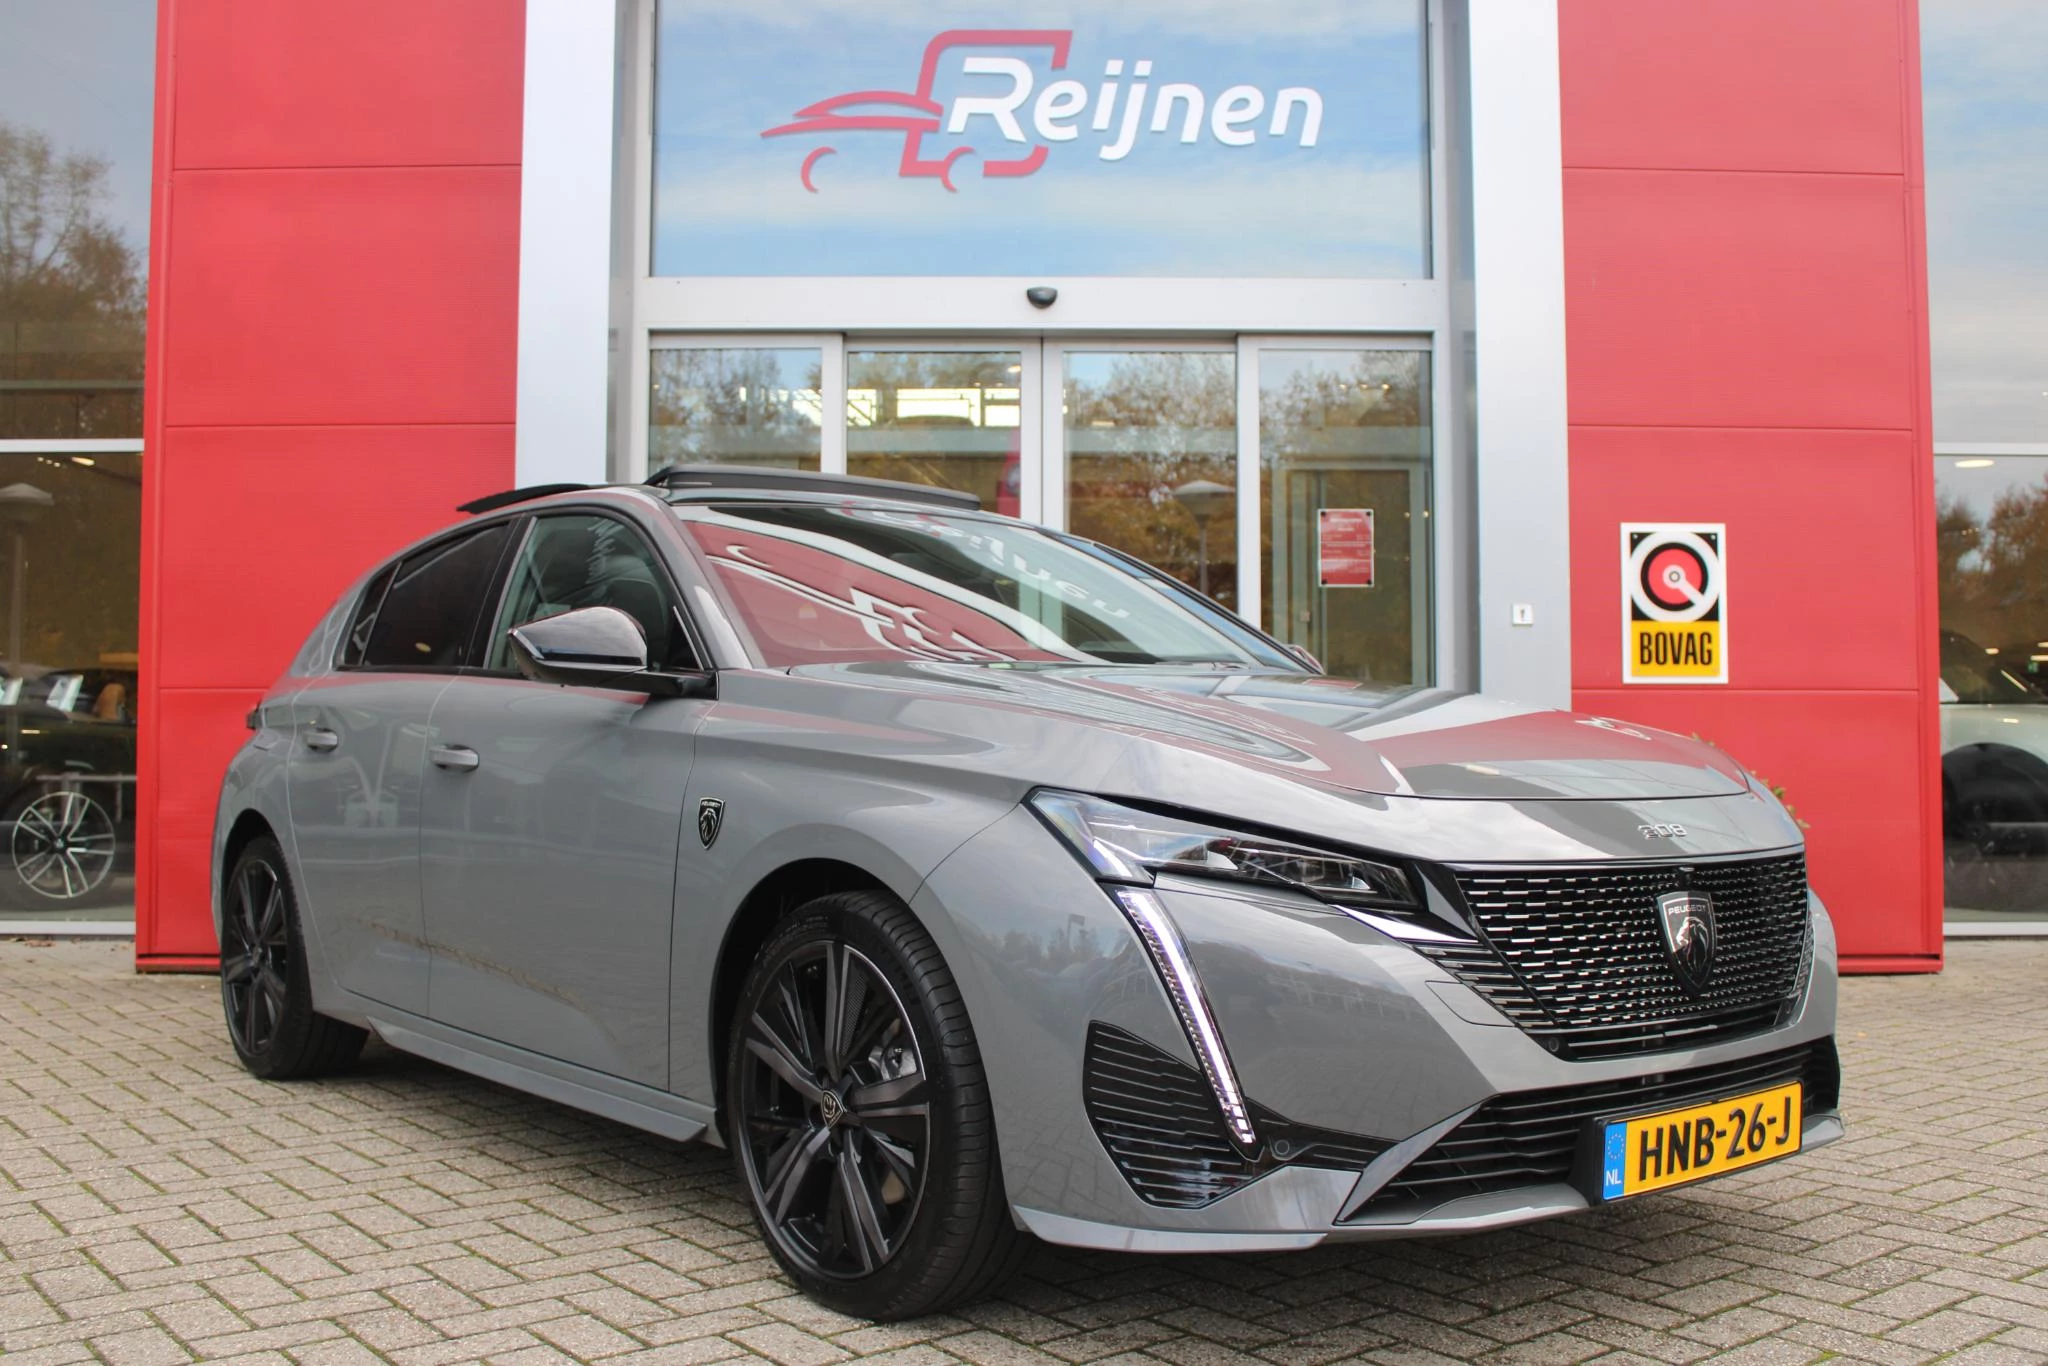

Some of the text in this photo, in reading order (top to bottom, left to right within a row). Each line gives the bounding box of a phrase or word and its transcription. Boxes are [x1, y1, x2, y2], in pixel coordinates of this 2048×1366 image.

[947, 57, 1324, 161] Reijnen
[1639, 631, 1713, 666] BOVAG
[1667, 904, 1706, 916] PEUGEOT
[1638, 1096, 1792, 1182] HNB-26-J
[1605, 1168, 1622, 1186] NL
